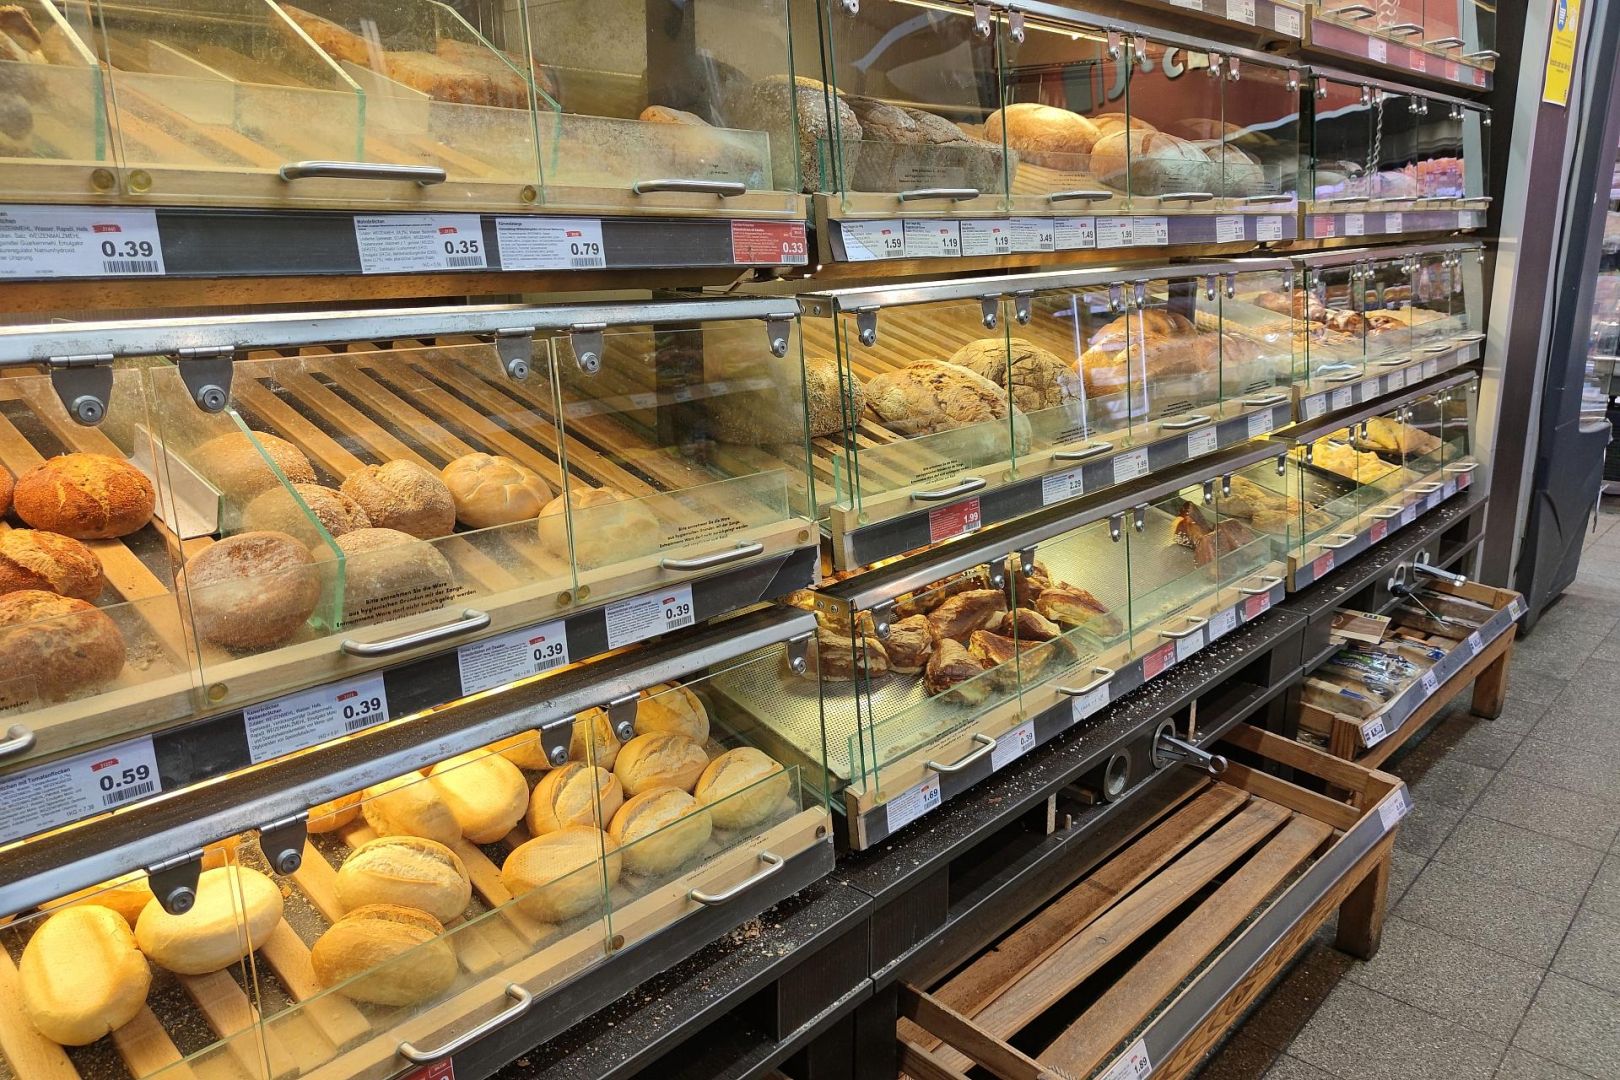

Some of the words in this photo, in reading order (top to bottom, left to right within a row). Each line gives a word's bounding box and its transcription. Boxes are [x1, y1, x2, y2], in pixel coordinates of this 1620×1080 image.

[994, 236, 1009, 246] 1.19
[1081, 230, 1094, 239] 1.49
[101, 240, 153, 258] 0.39
[444, 239, 479, 256] 0.35
[570, 242, 600, 257] 0.79
[782, 242, 804, 253] 0.33
[884, 238, 902, 249] 1.59
[942, 238, 958, 248] 1.19
[963, 511, 979, 524] 1.99
[665, 603, 690, 620] 0.39
[533, 642, 563, 661] 0.39
[343, 697, 381, 720] 0.39
[1020, 732, 1033, 745] 0.39
[100, 764, 150, 792] 0.59
[923, 788, 938, 803] 1.69
